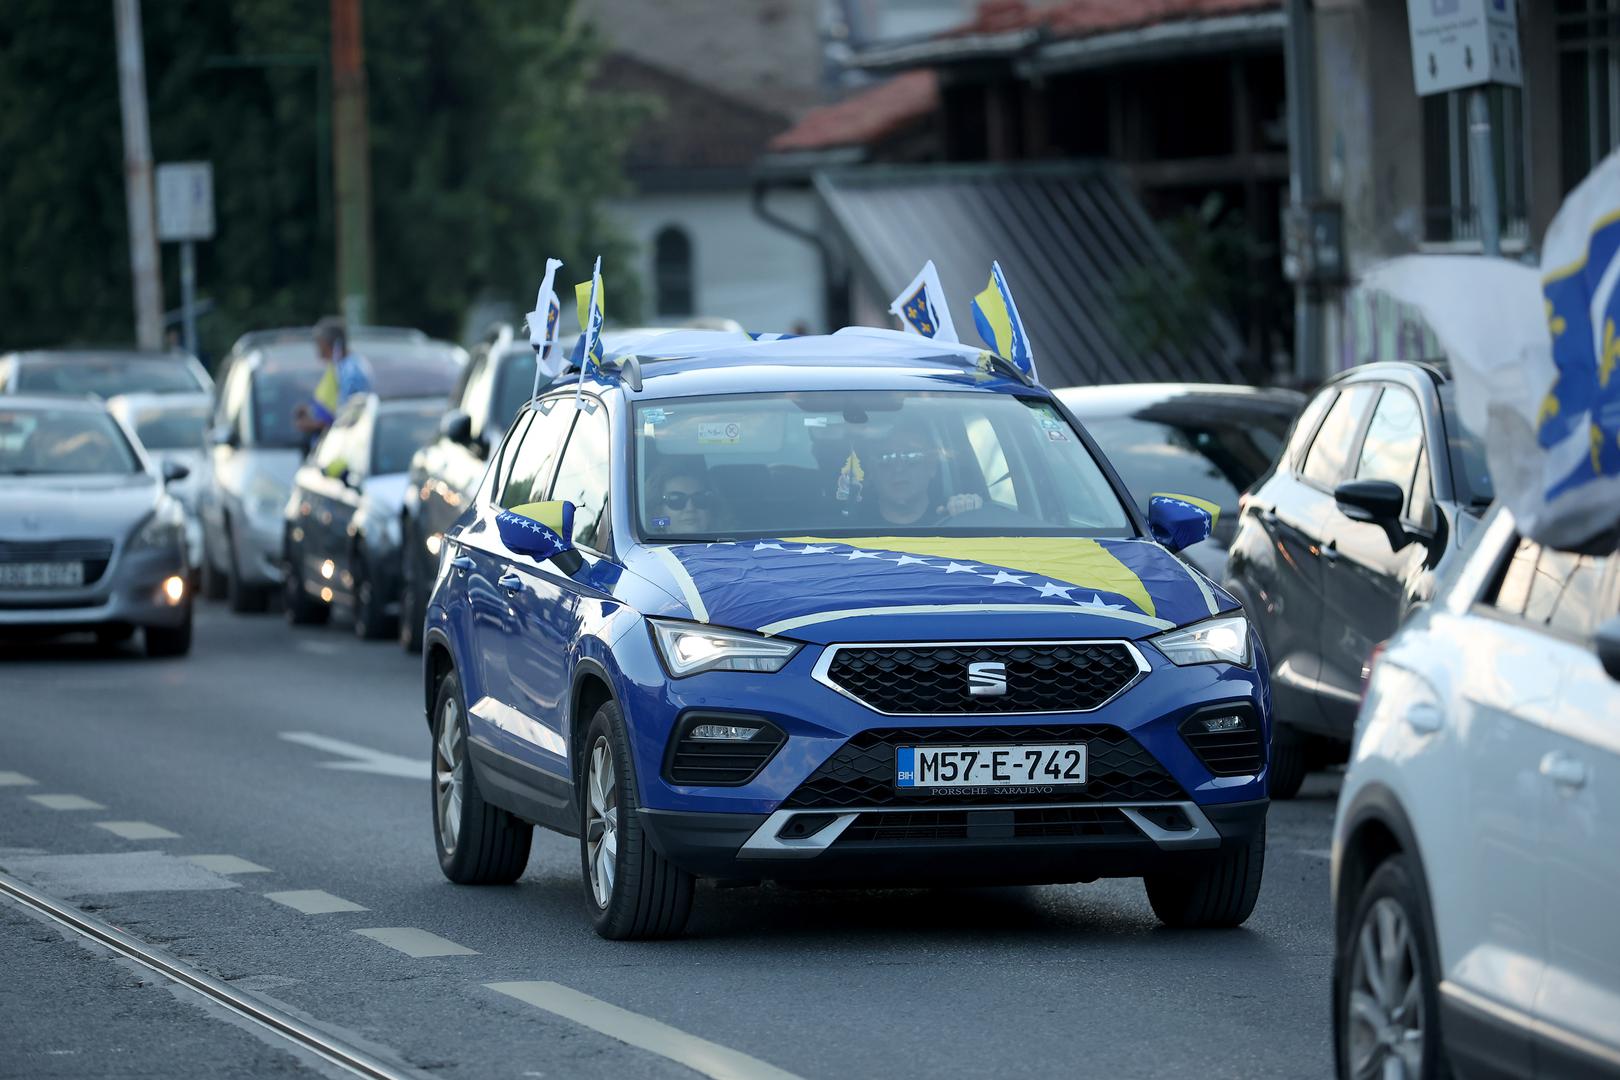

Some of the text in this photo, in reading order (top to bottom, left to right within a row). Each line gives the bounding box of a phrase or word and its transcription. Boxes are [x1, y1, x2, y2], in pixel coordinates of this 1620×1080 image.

[919, 750, 1081, 782] M57-E-742
[898, 771, 914, 780] BIH
[931, 786, 1053, 796] PORSCHE SARAJEVO
